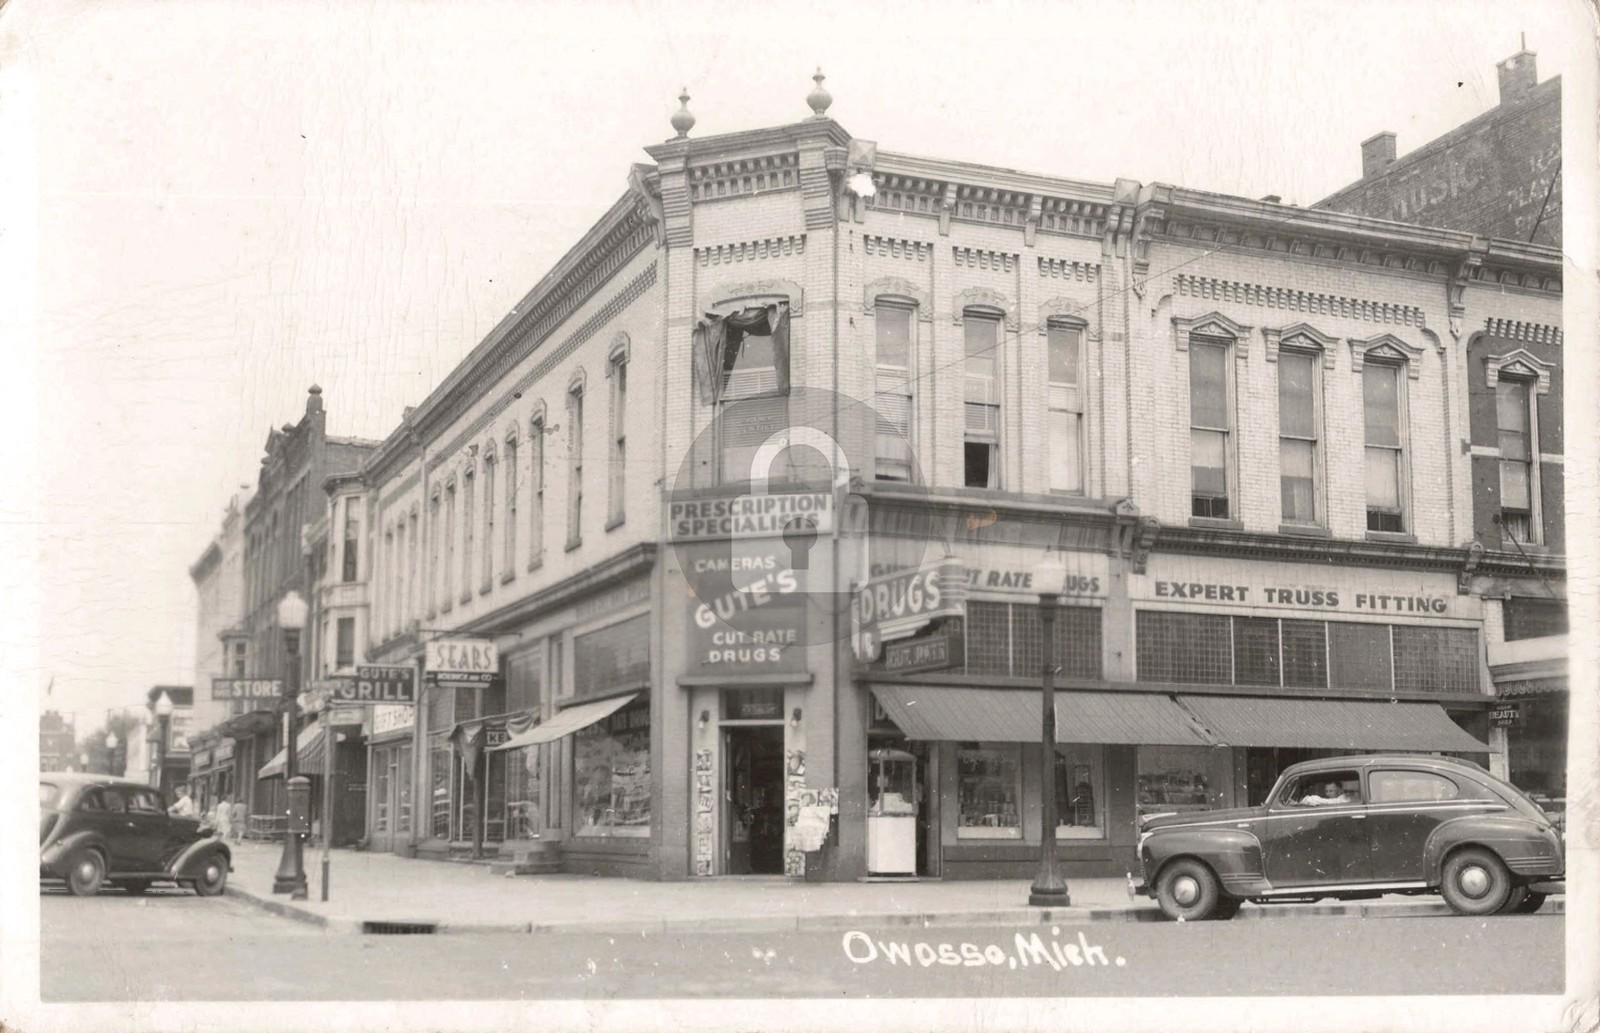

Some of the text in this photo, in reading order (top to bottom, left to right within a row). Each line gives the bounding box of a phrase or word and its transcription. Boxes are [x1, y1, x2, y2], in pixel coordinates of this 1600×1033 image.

[671, 495, 827, 520] PRESCRIPTION
[677, 513, 821, 536] SPECIALISTS
[695, 556, 776, 572] CAMERAS
[986, 570, 1033, 588] RATE
[1062, 575, 1100, 593] UGS
[695, 568, 798, 628] GUTE'S
[861, 571, 941, 624] DRUGS
[1155, 581, 1448, 614] EXPERT TRUSS FITTING
[713, 629, 797, 646] CUT RATE
[437, 644, 492, 669] SEARS
[709, 648, 781, 663] DRUGS
[360, 667, 410, 679] GUTE'S
[233, 680, 282, 697] STORE
[340, 680, 410, 700] GRILL
[1489, 709, 1519, 719] BEAUTY
